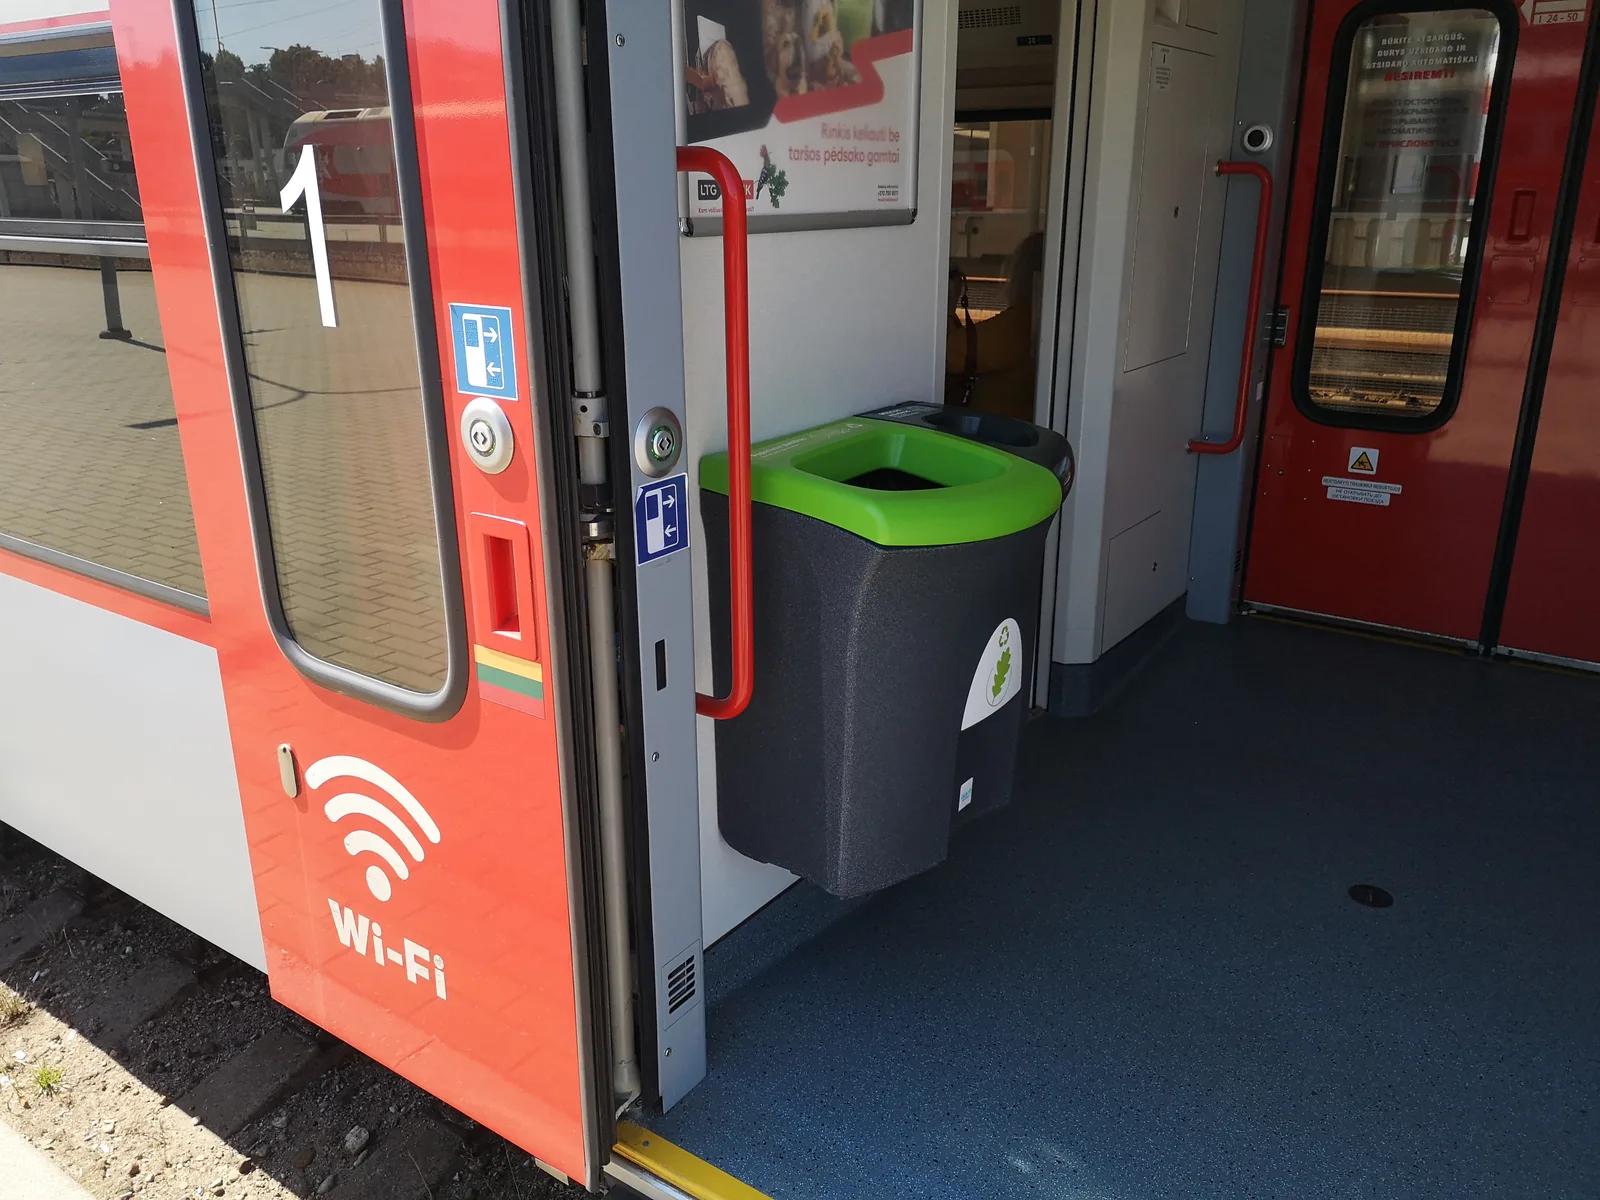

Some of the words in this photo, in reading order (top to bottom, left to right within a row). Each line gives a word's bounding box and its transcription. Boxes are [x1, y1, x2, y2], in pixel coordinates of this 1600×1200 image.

[1546, 14, 1559, 23] 24
[1566, 12, 1578, 22] 50
[821, 122, 850, 140] Rinkis
[888, 125, 901, 142] be
[788, 144, 821, 161] taršos
[823, 146, 865, 166] pėdsako
[866, 148, 900, 167] gamtai
[700, 184, 717, 196] LTG
[280, 144, 337, 328] 1
[327, 897, 447, 1001] Wi-Fi
